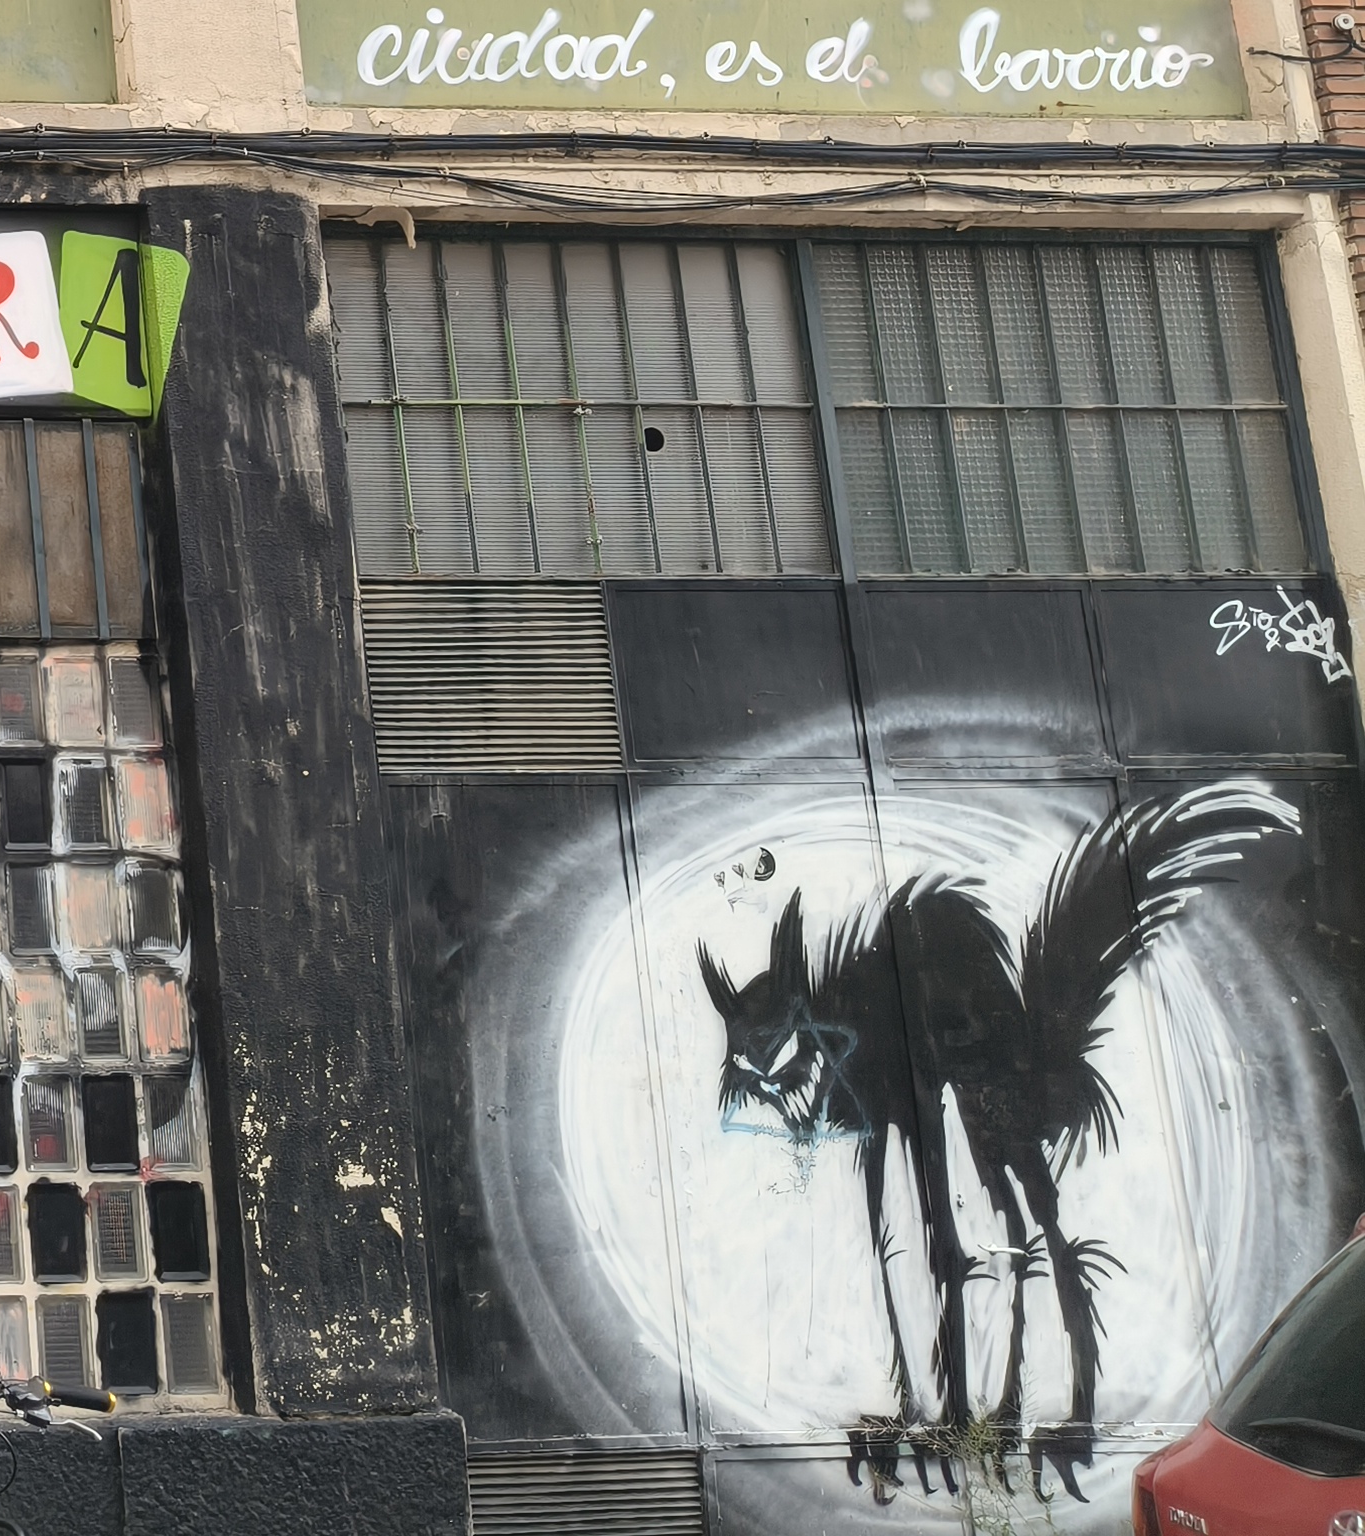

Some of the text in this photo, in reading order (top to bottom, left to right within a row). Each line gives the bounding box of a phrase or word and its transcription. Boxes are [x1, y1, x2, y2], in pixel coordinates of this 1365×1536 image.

[356, 5, 1215, 100] ciudad, es el barrio
